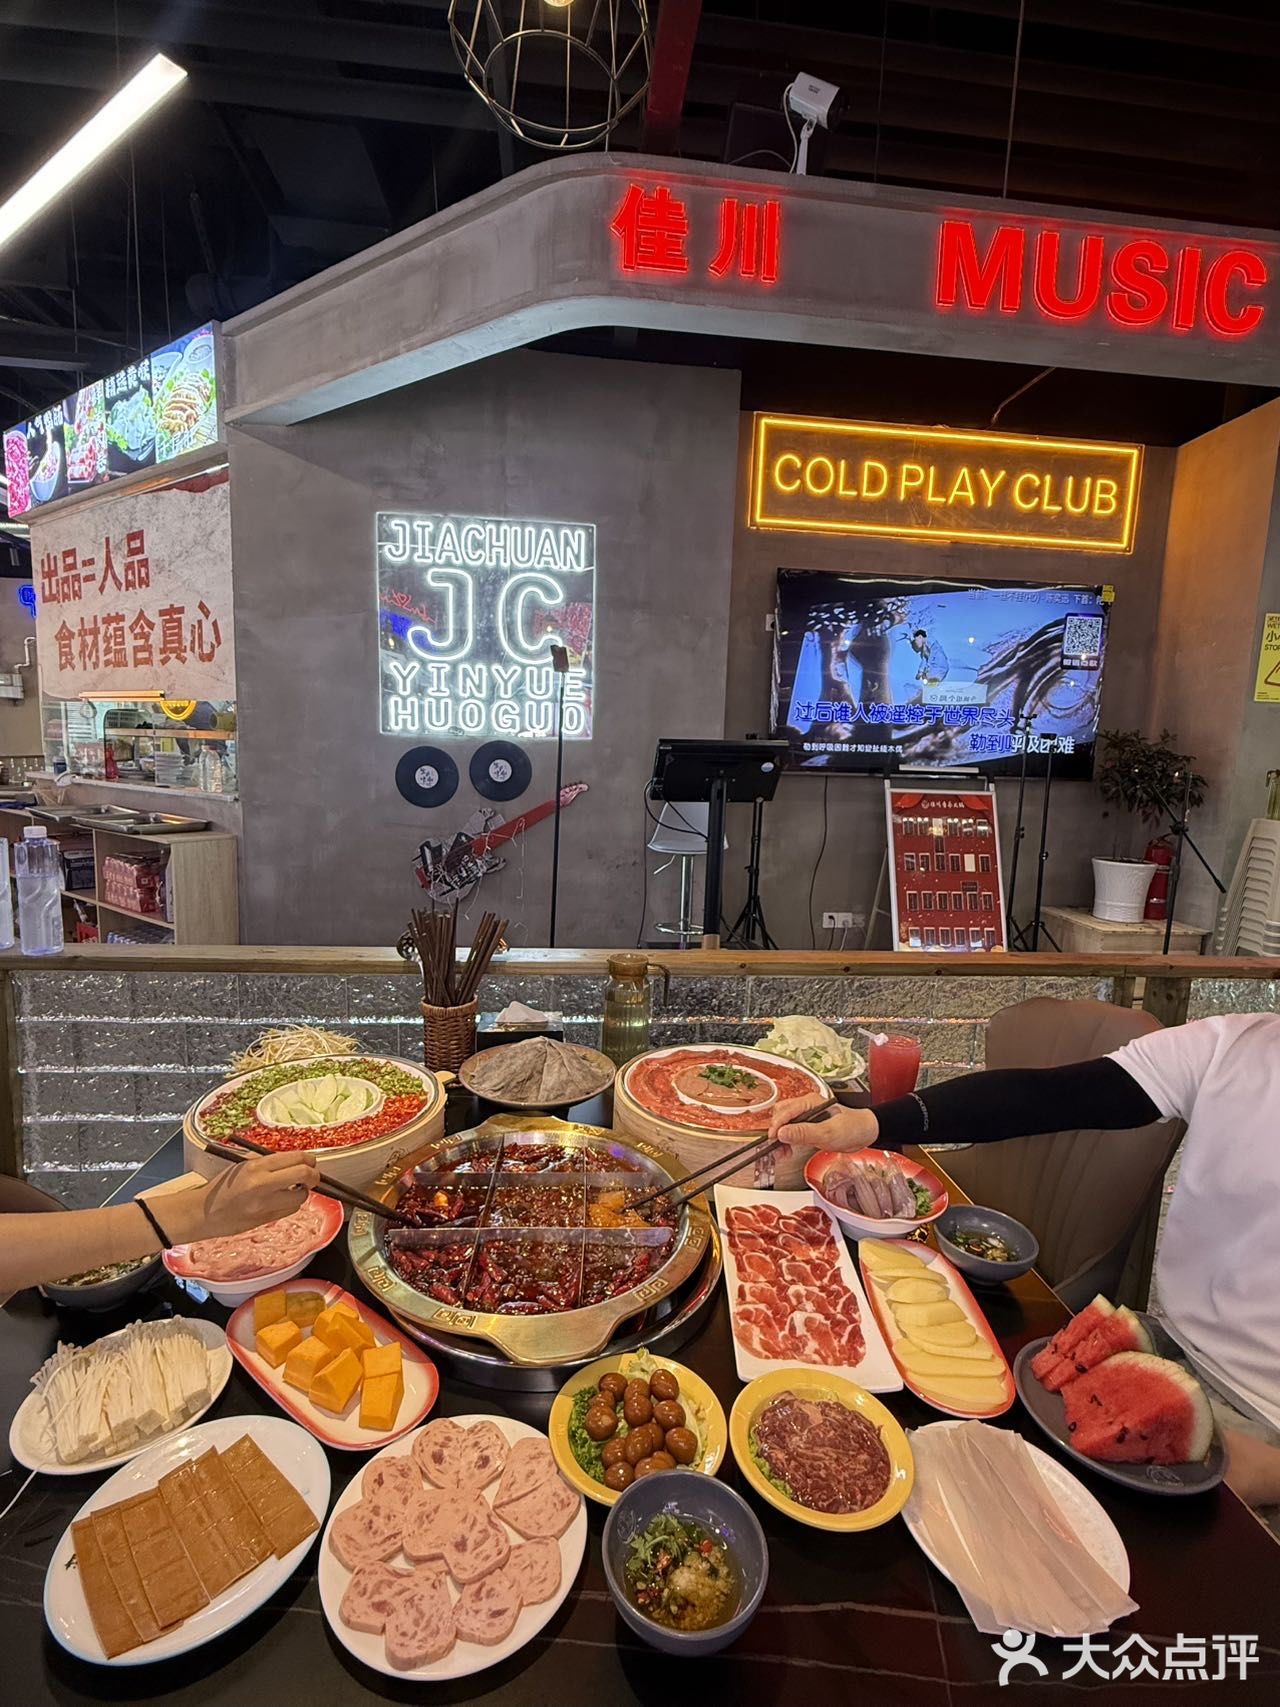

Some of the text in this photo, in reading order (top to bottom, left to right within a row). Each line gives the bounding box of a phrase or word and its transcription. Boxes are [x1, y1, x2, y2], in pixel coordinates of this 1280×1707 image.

[609, 182, 1268, 335] 佳川 MUSIC
[773, 453, 1118, 516] COLD PLAY CLUB
[40, 529, 151, 605] 出品=人品
[384, 520, 586, 571] JIACHUAN
[54, 600, 222, 672] 食材蕴含真心
[407, 567, 564, 664] JC
[389, 662, 586, 701] YINYUE
[389, 697, 586, 734] HUOGUO
[794, 701, 1016, 728] 过后谁人被遥控于世界尽头
